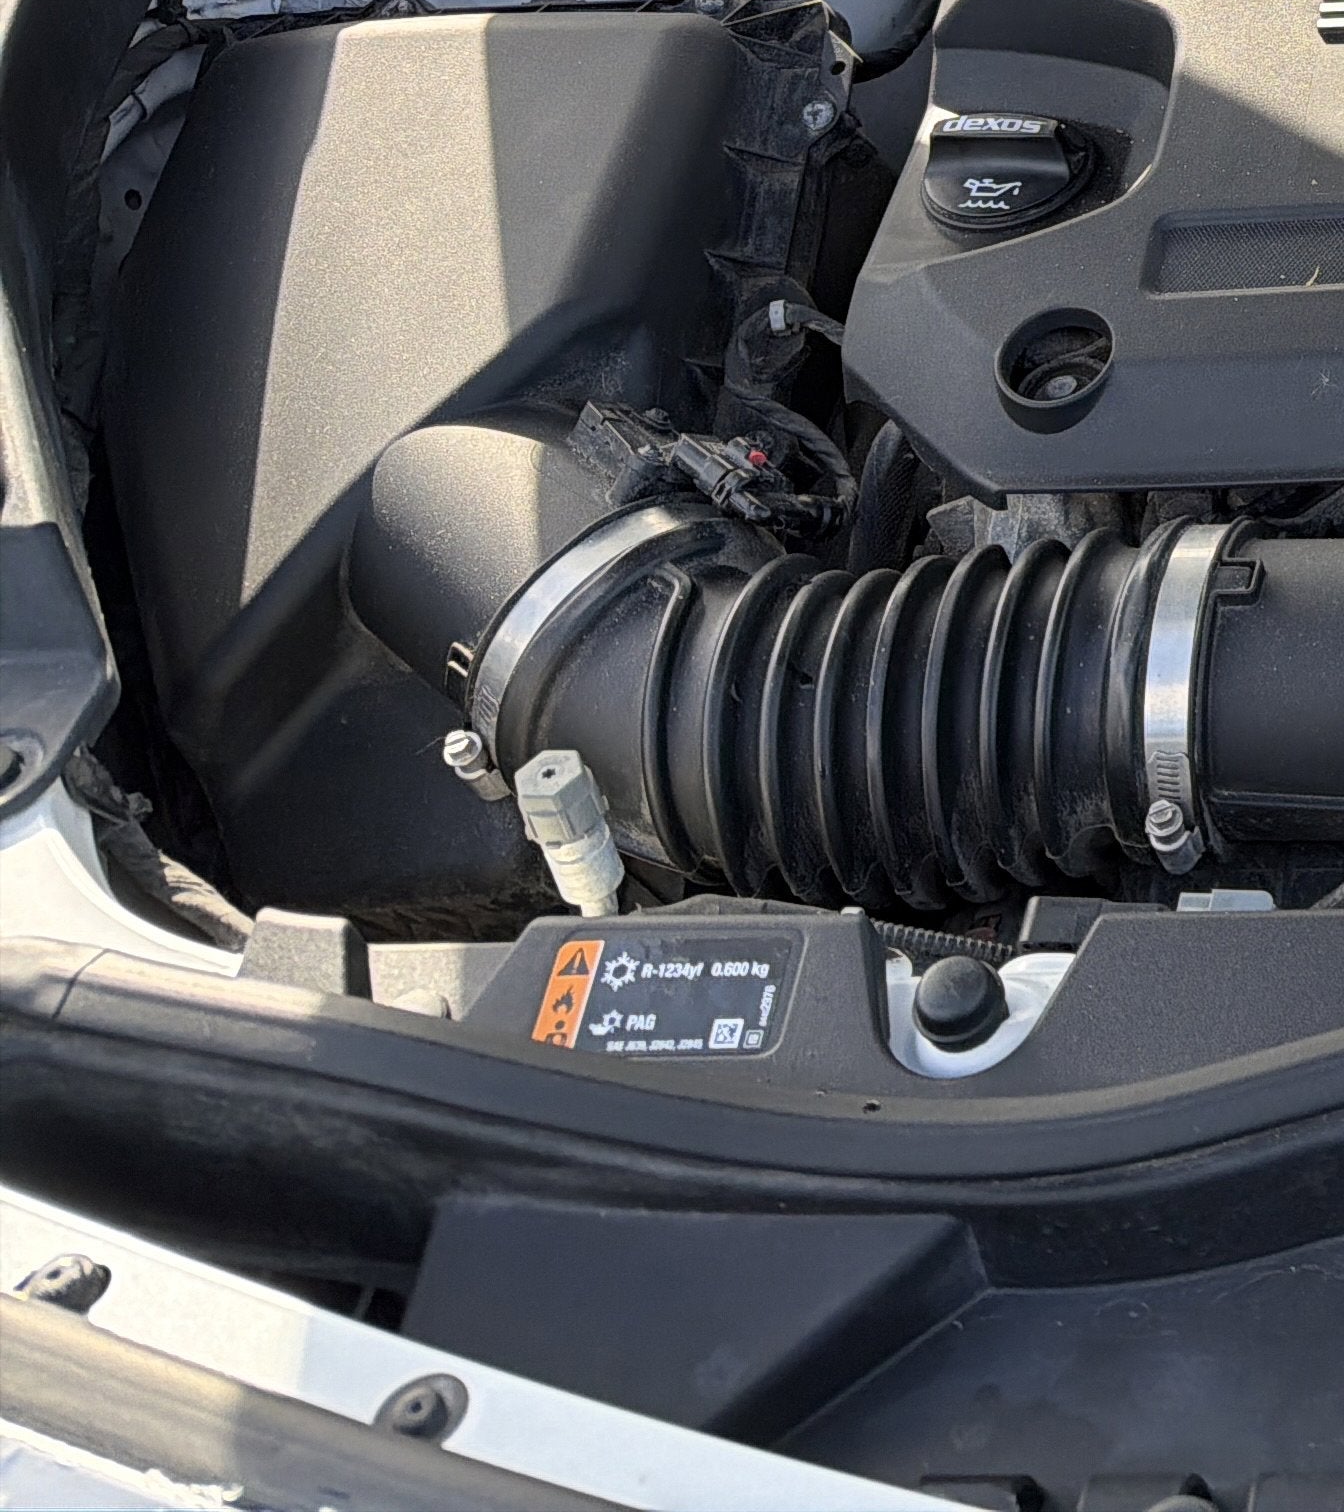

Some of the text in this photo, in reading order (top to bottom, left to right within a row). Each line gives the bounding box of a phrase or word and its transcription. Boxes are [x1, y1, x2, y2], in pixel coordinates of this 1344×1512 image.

[942, 115, 1043, 135] dexos
[641, 961, 770, 980] R-1234yf 0.600 kg
[626, 1014, 657, 1031] PAG
